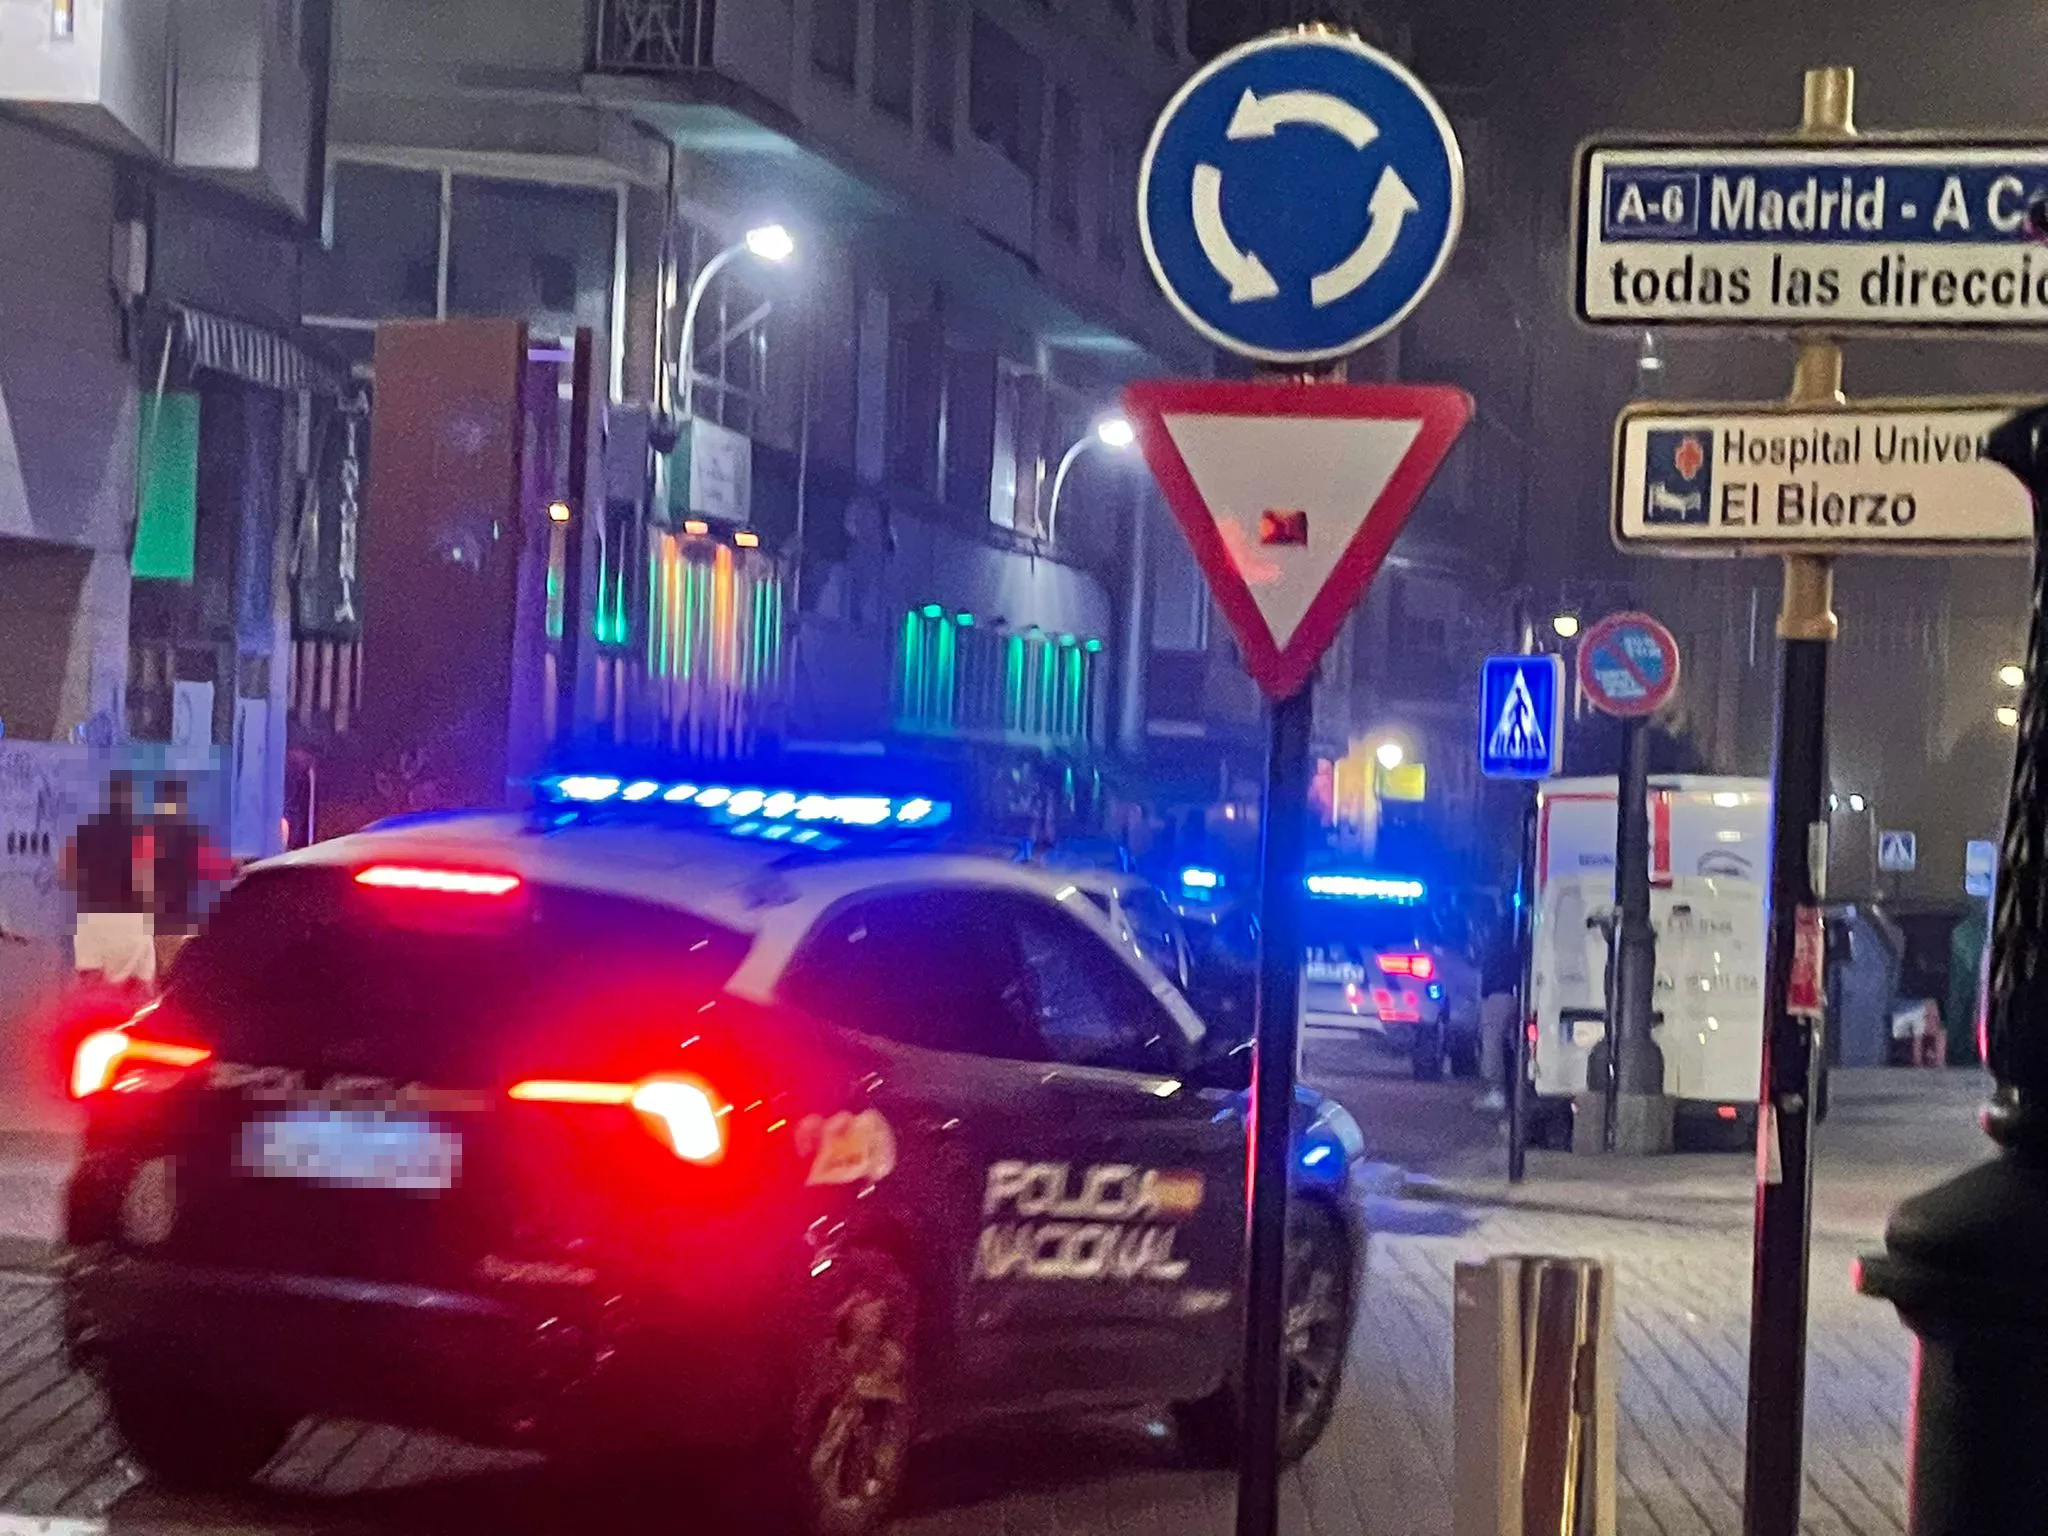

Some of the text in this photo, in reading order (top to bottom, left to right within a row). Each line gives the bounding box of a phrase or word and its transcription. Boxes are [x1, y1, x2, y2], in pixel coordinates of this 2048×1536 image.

[1617, 182, 1684, 224] A-6
[1710, 173, 1886, 232] Madrid
[1932, 175, 1970, 232] A
[1987, 173, 2048, 233] C
[1610, 252, 1751, 306] todas
[1771, 252, 1840, 307] las
[1723, 427, 1861, 475] Hospital
[1720, 480, 1917, 527] El Bierzo
